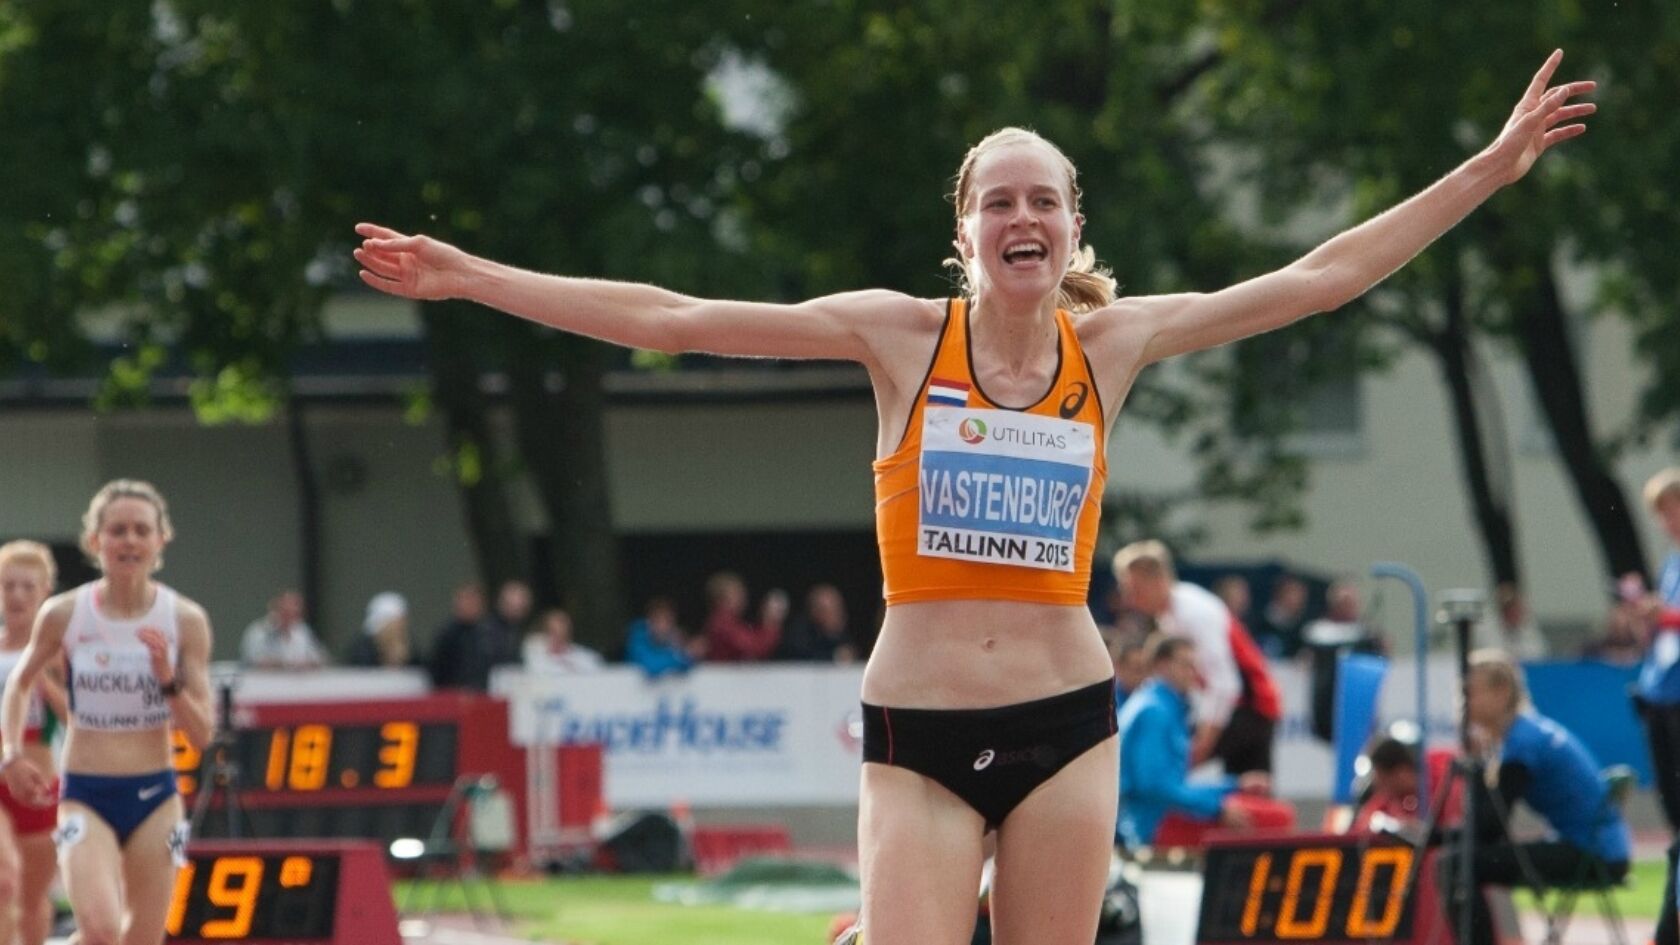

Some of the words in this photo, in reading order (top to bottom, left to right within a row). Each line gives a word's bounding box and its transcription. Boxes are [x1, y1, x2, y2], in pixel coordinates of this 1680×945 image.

[992, 426, 1067, 450] UTILITAS
[921, 468, 1083, 530] VASTENBURG
[923, 529, 1028, 561] TALLINN
[1034, 540, 1070, 567] 2015
[76, 672, 161, 695] AUCKLAN
